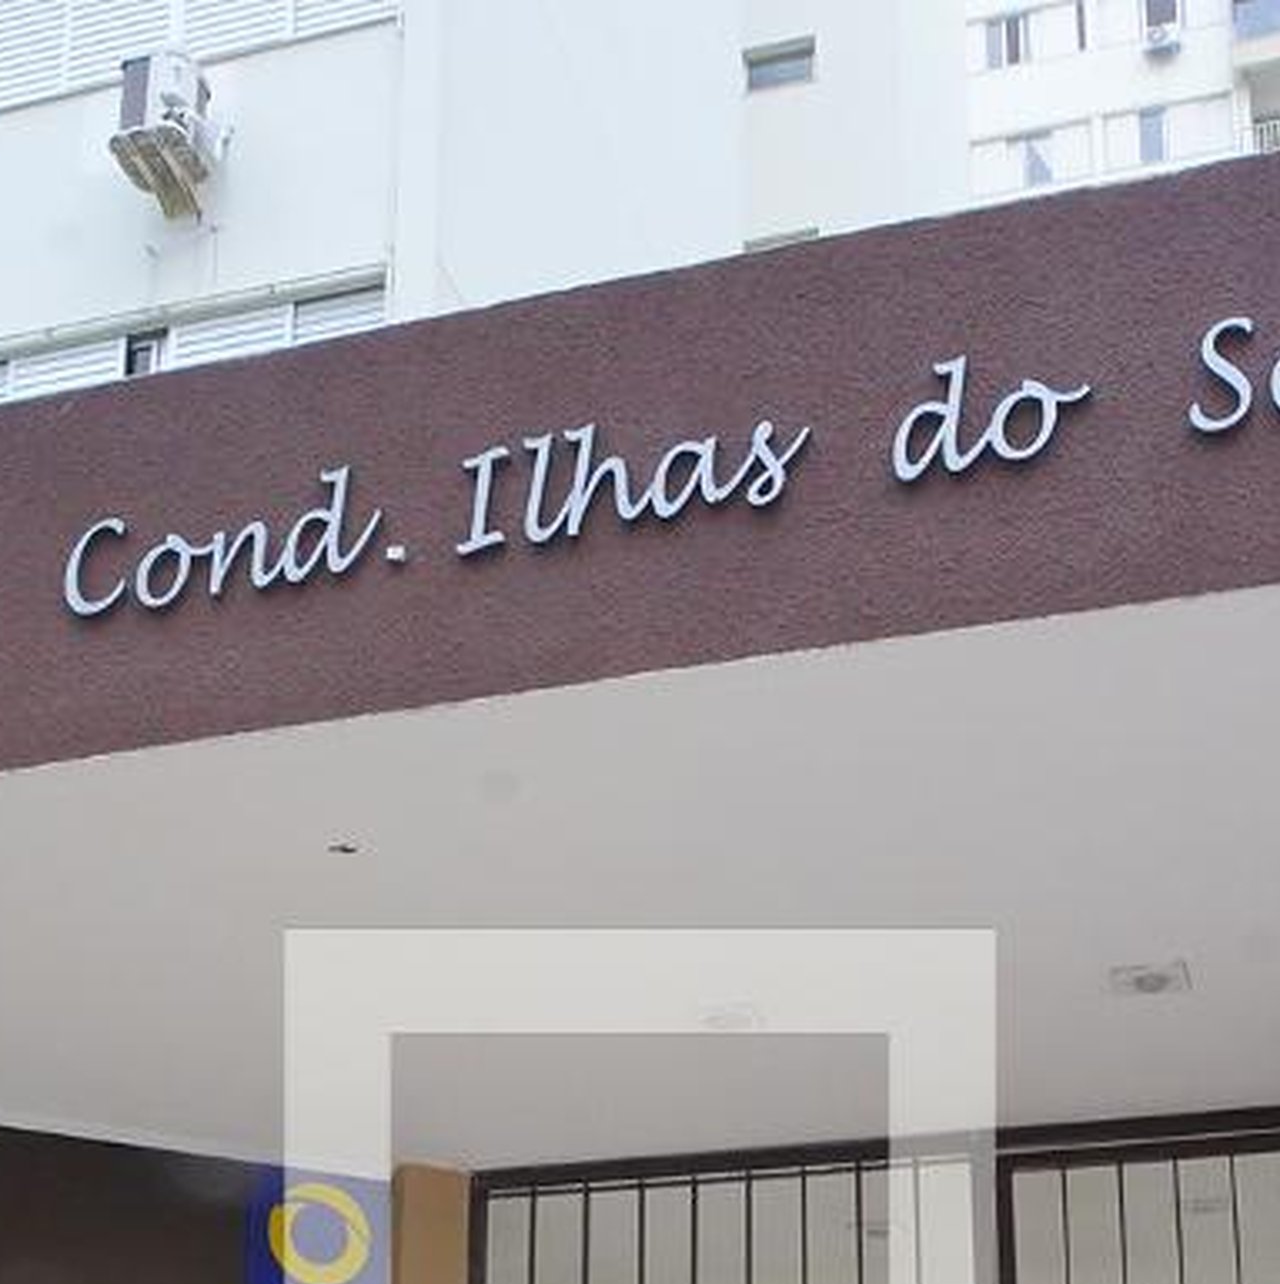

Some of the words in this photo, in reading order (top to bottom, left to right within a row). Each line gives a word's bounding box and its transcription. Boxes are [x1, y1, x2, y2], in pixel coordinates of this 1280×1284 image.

[63, 465, 406, 619] Cond.
[455, 419, 812, 556] Ilhas
[891, 354, 1091, 482] do
